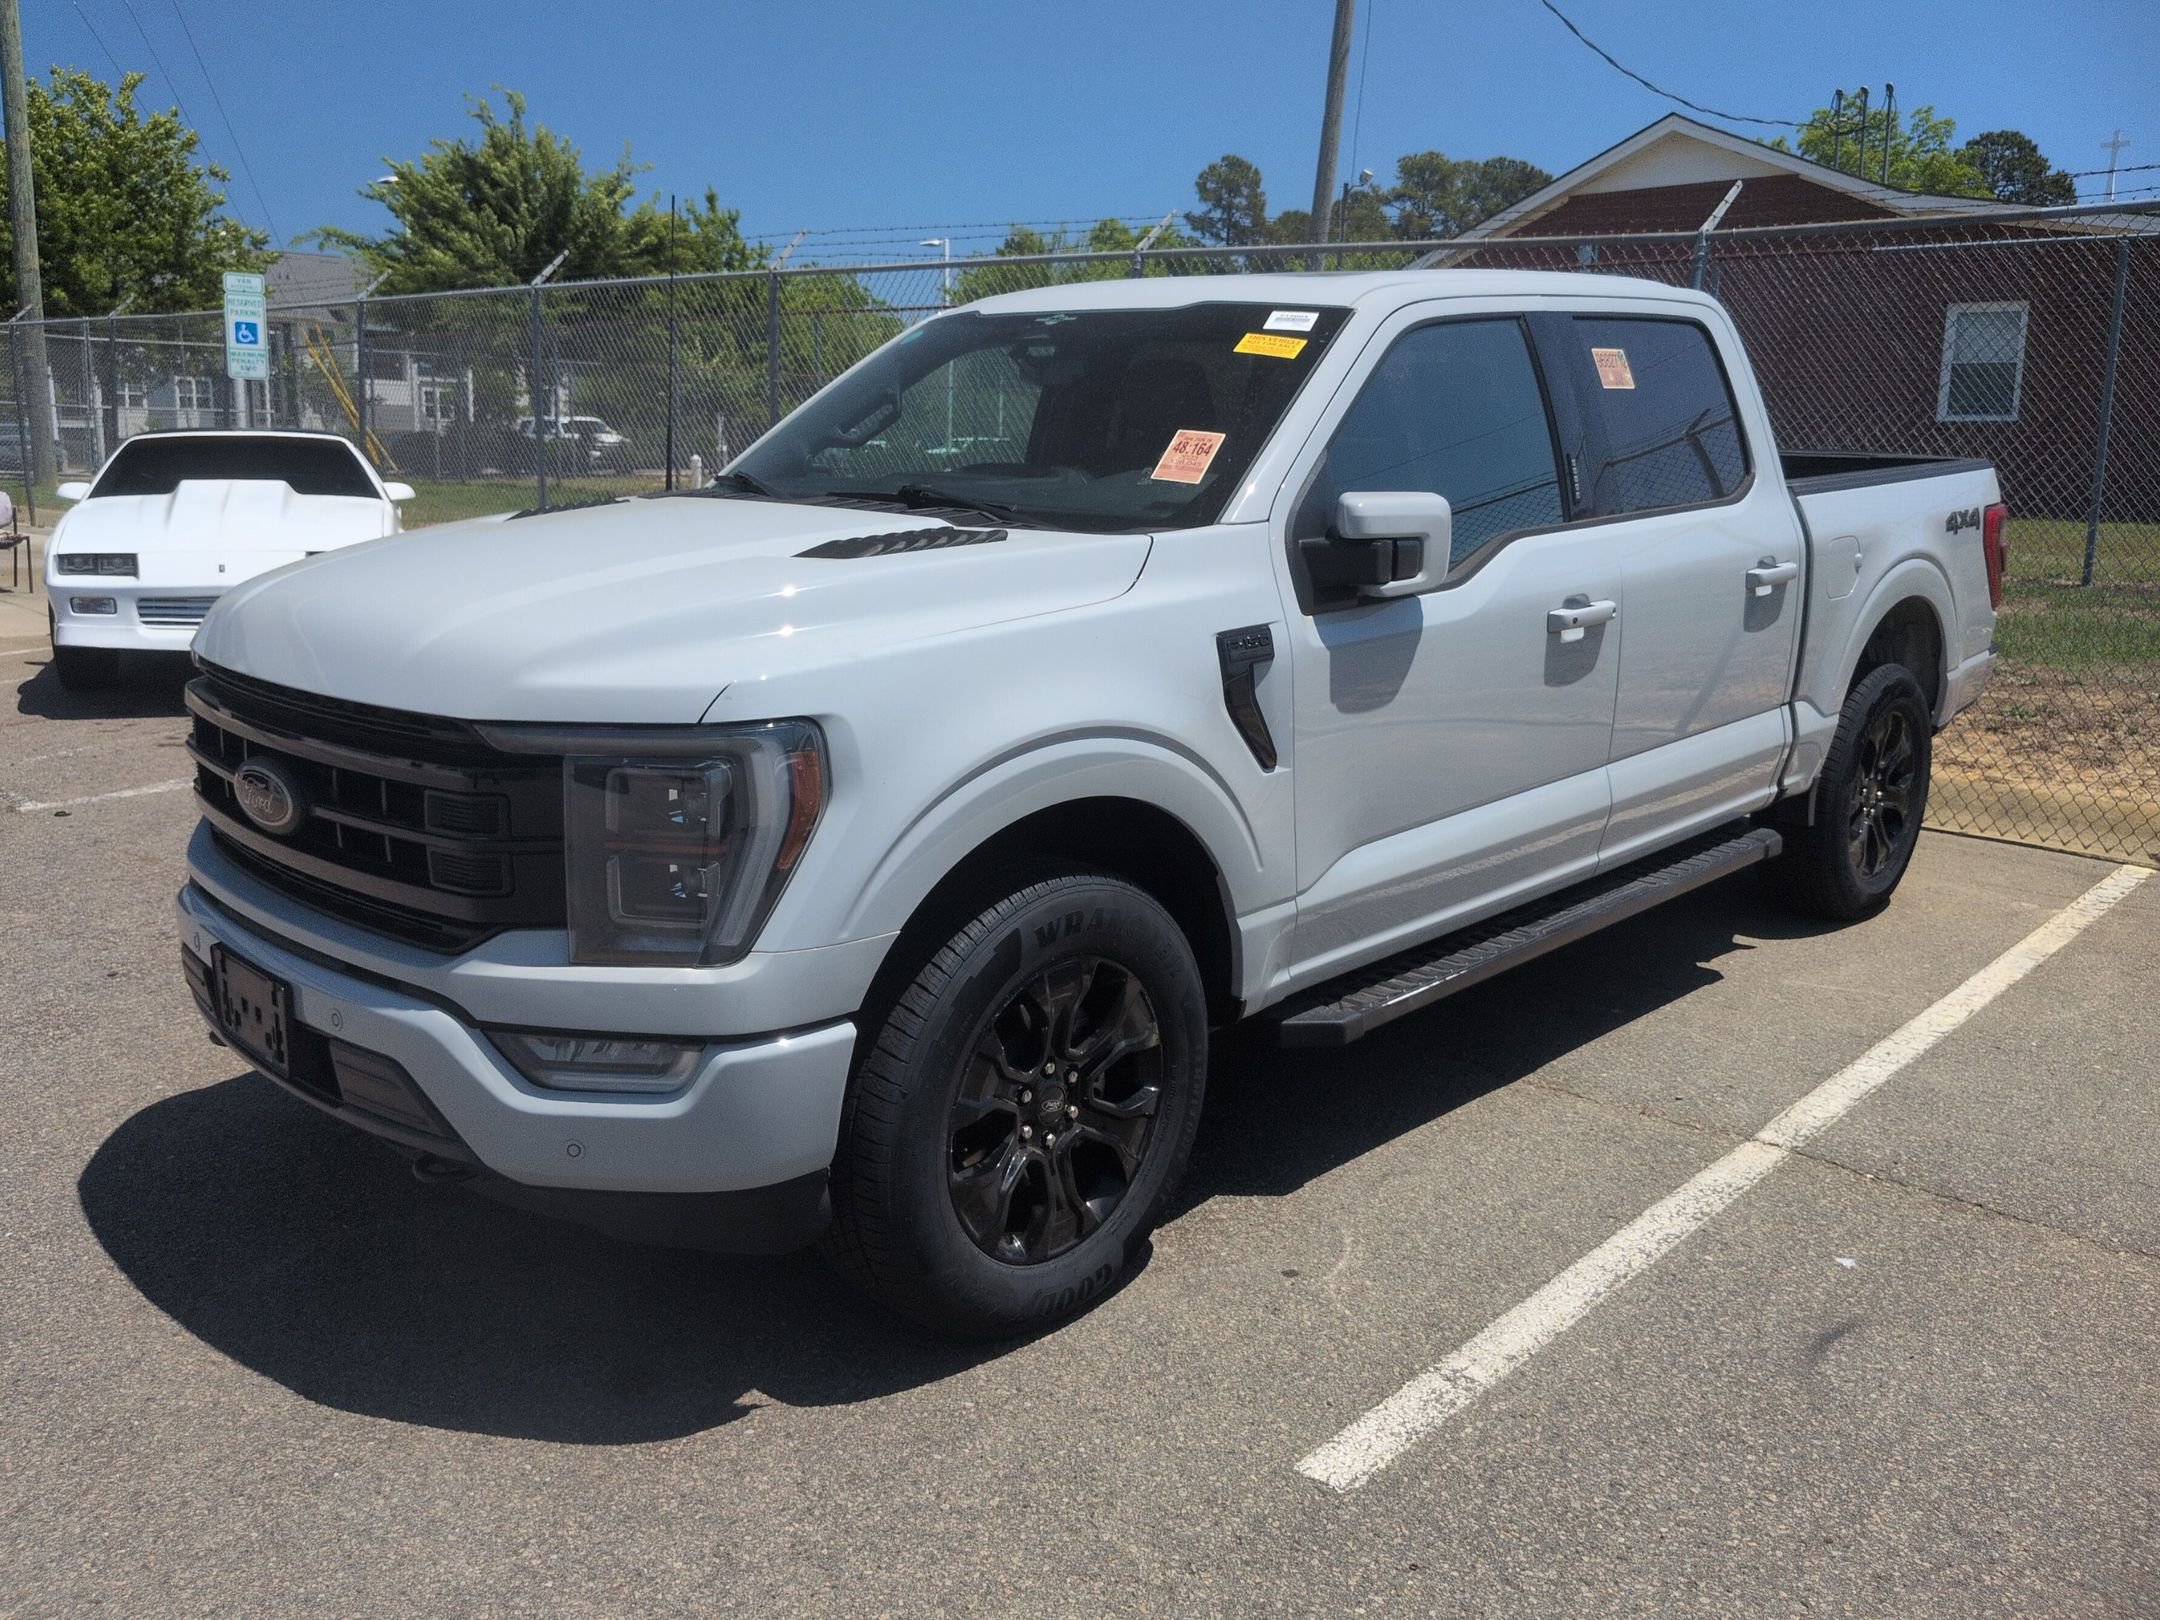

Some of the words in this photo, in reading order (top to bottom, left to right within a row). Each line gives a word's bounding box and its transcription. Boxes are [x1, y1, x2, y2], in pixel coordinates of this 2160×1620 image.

[228, 297, 263, 308] RESERVED
[230, 307, 262, 318] PARKING
[231, 357, 265, 365] PENALTY
[243, 776, 274, 815] Ford
